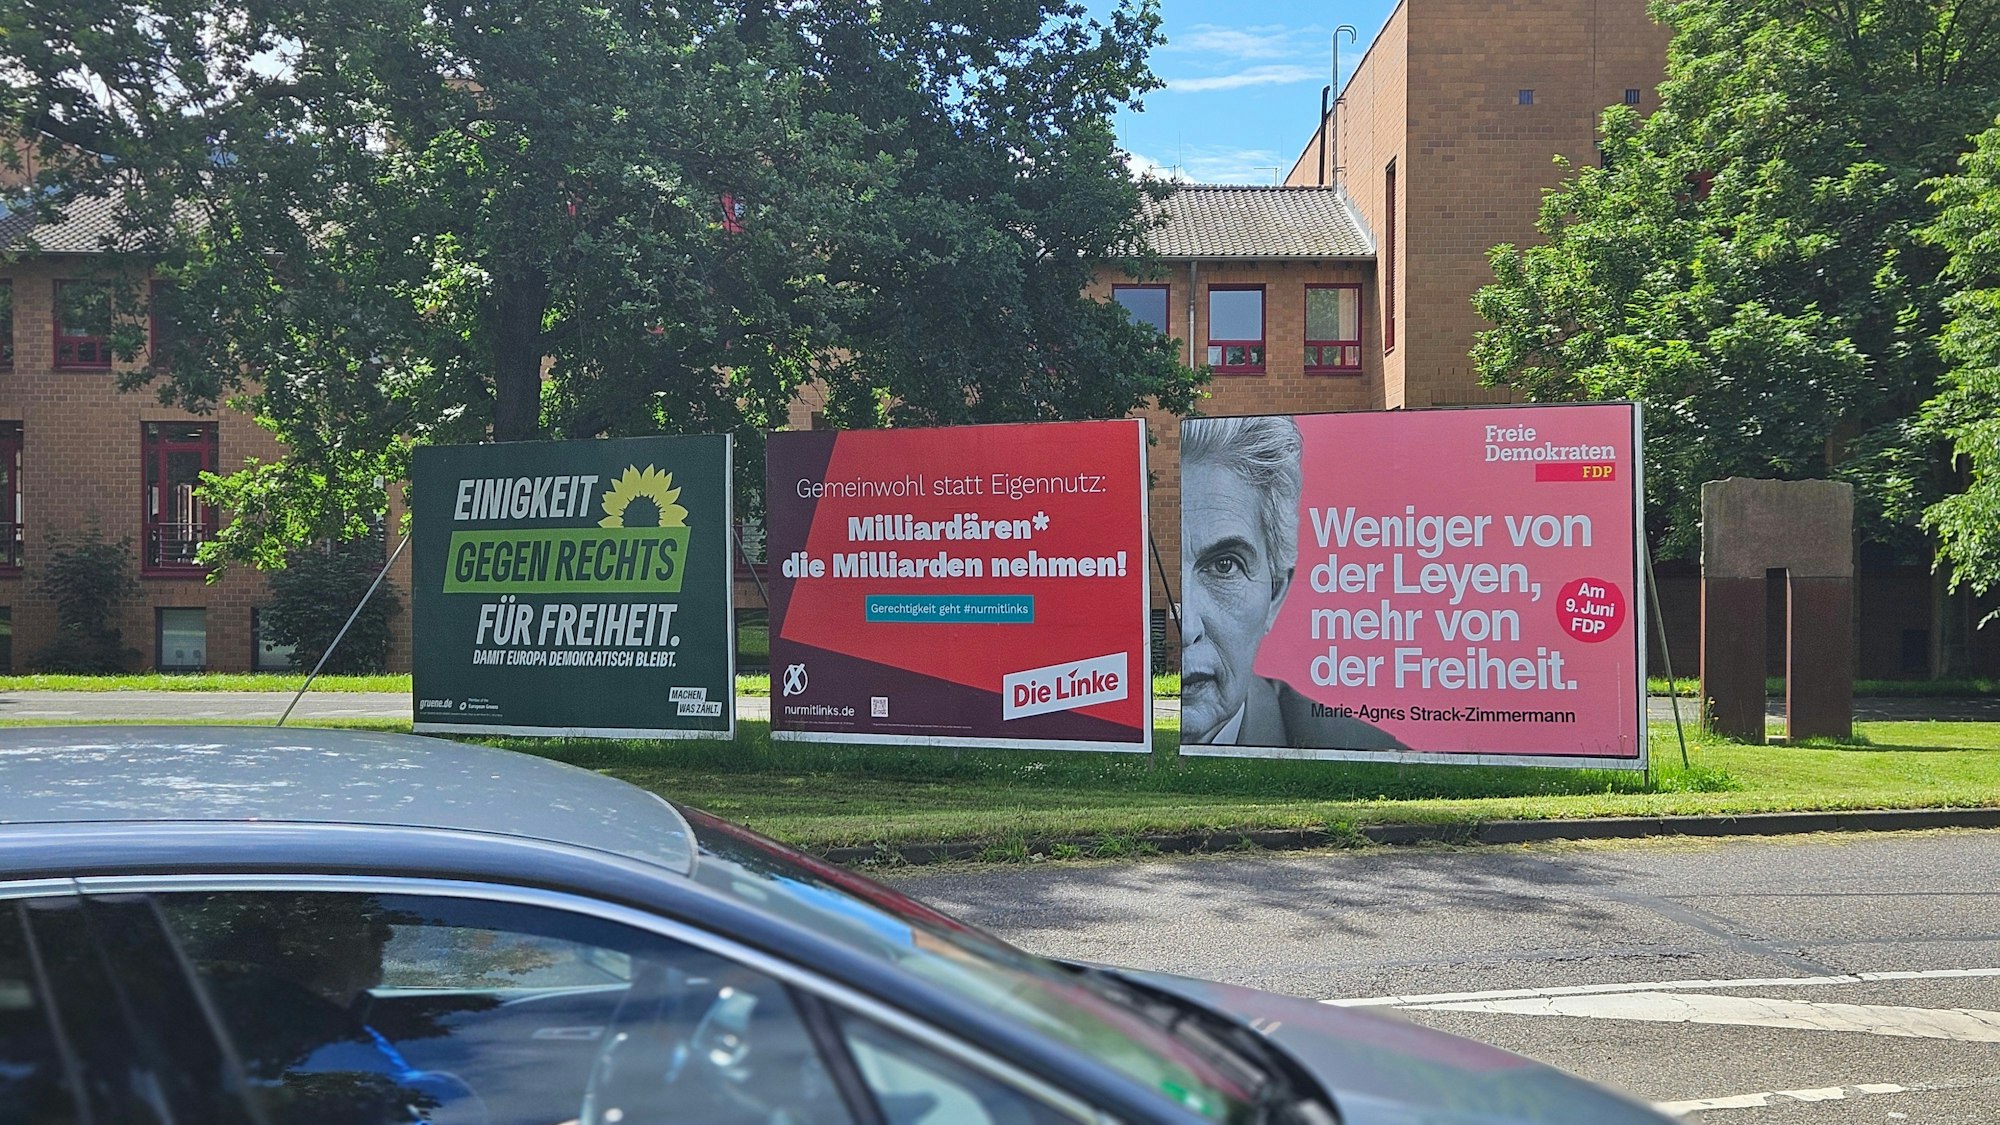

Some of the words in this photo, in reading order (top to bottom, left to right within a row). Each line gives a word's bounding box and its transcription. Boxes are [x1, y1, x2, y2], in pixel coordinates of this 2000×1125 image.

[1485, 423, 1537, 443] Freie
[1485, 443, 1616, 462] Demokraten
[1582, 465, 1613, 478] FDP
[796, 474, 926, 499] Gemeinwohl
[933, 474, 983, 496] statt
[991, 472, 1106, 500] Eigennutz:
[454, 475, 598, 520] EINIGKEIT
[1309, 505, 1491, 558] Weniger
[1504, 513, 1592, 548] von
[455, 541, 551, 582] GEGEN
[555, 538, 677, 581] RECHTS
[782, 552, 825, 578] die
[833, 551, 982, 578] Milliarden
[991, 551, 1127, 578] nehmen!
[1310, 554, 1383, 594] der
[1393, 554, 1542, 605] Leyen,
[1577, 583, 1605, 599] Am
[870, 602, 936, 616] Gerechtigkeit
[939, 603, 961, 616] geht
[964, 602, 1028, 615] #nurmitlinks
[1566, 598, 1581, 613] 9.
[1582, 601, 1614, 618] Juni
[475, 595, 534, 646] FÜR
[538, 603, 681, 647] FREIHEIT.
[1311, 599, 1422, 641] mehr
[1435, 609, 1520, 642] von
[1571, 618, 1606, 635] FDP
[473, 650, 505, 665] DAMIT
[507, 650, 547, 666] EUROPA
[549, 651, 634, 667] DEMOKRATISCH
[635, 651, 677, 667] BLEIBT.
[1310, 646, 1383, 687] der
[1395, 647, 1577, 690] Freiheit.
[671, 690, 704, 701] MACHEN,
[1013, 680, 1051, 708] Die
[1056, 667, 1119, 699] Linke
[420, 698, 453, 710] gruene.de
[679, 704, 695, 713] WAS
[784, 704, 855, 717] nurmitlinks.de
[1311, 703, 1405, 723] Marie-Agnes
[1410, 707, 1576, 724] Strack-Zimmermann
